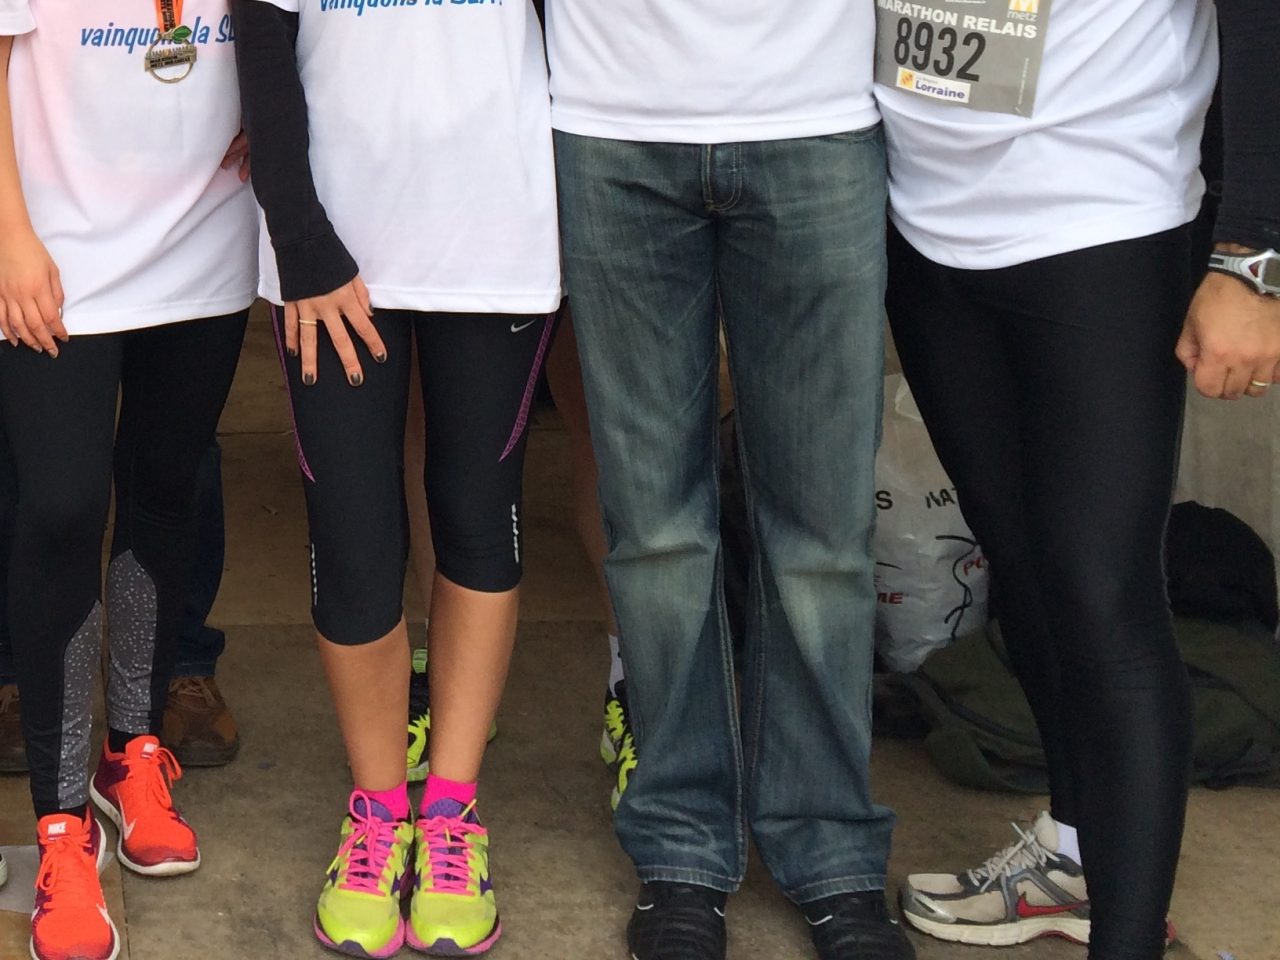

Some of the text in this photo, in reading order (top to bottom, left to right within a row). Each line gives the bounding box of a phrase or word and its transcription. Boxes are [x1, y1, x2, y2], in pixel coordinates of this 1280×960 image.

[962, 14, 1038, 39] RELAIS
[1006, 9, 1038, 21] metz
[191, 16, 210, 45] la
[894, 16, 987, 82] 8932
[915, 79, 966, 100] Lorraine
